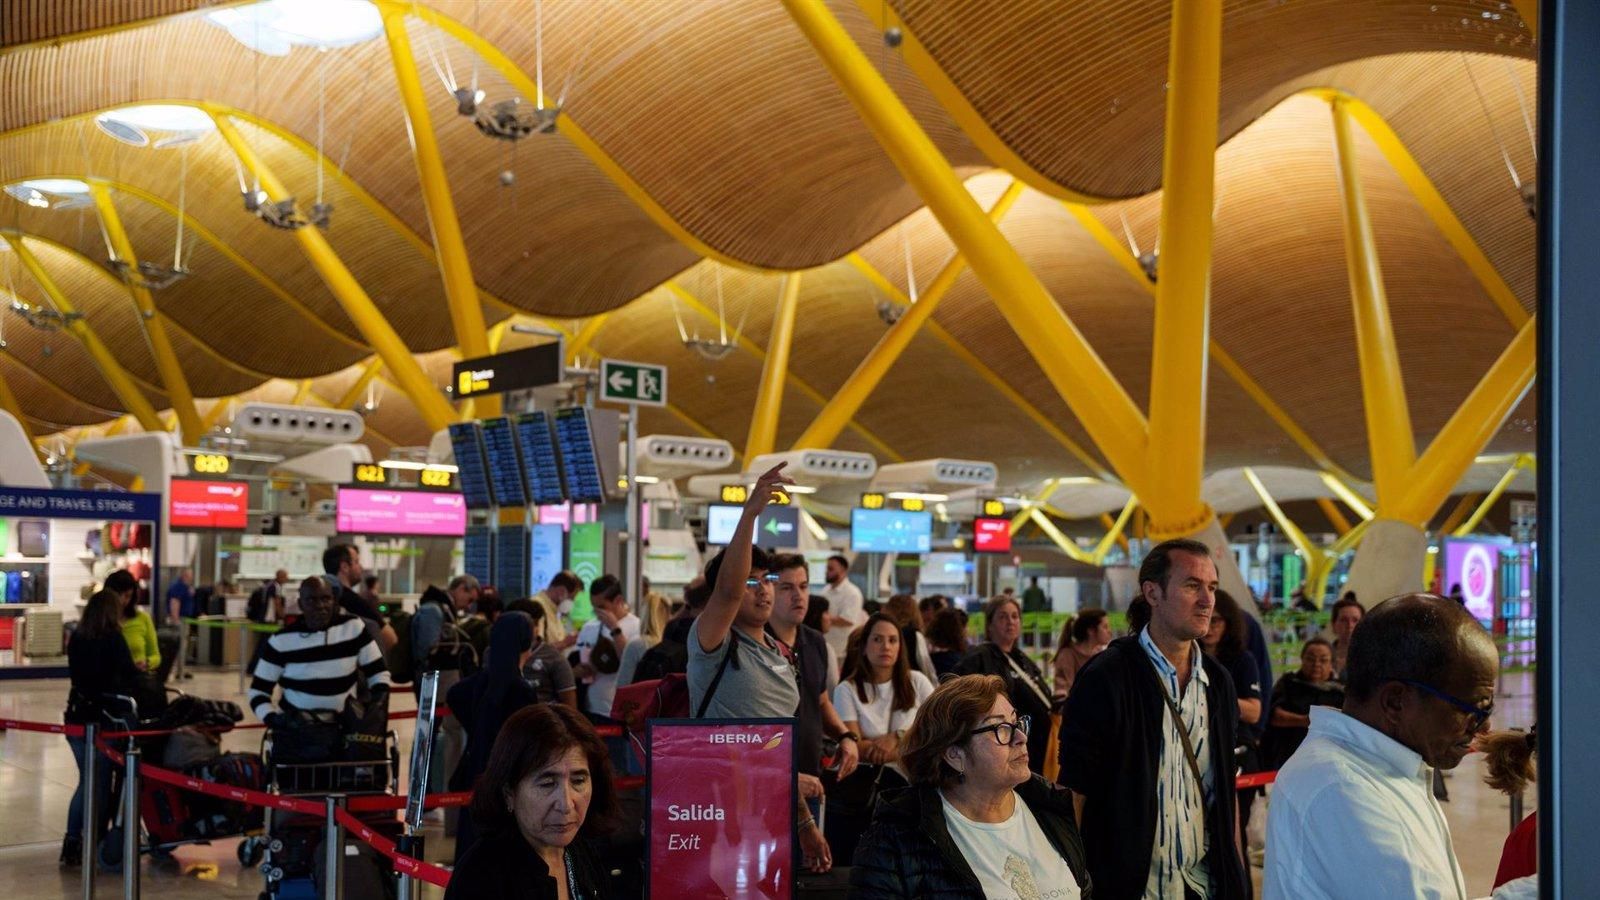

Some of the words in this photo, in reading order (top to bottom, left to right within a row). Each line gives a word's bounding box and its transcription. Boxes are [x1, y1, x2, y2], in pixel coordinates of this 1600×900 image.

[18, 496, 47, 509] AND
[49, 497, 95, 511] TRAVEL
[97, 499, 136, 512] STORE
[709, 733, 763, 744] IBERIA
[667, 804, 725, 821] Salida
[667, 833, 701, 850] Exit
